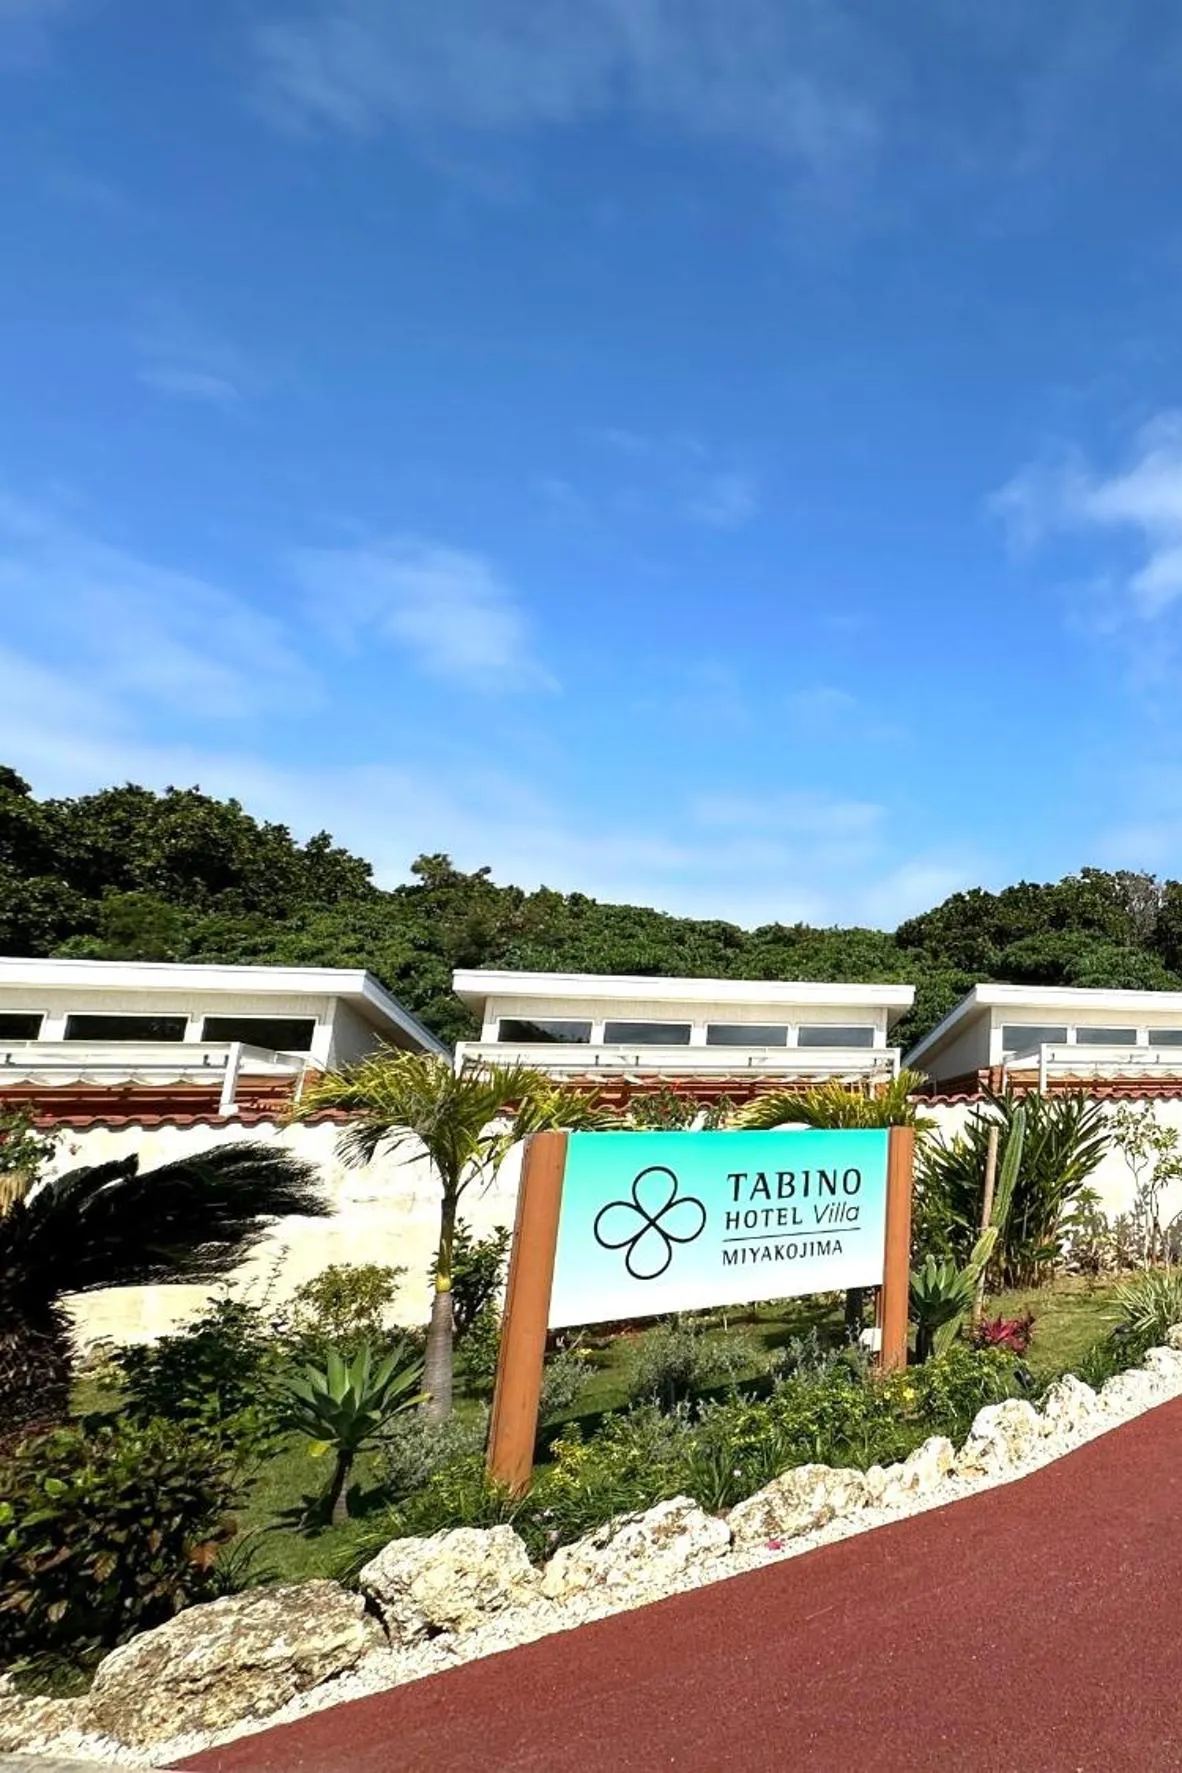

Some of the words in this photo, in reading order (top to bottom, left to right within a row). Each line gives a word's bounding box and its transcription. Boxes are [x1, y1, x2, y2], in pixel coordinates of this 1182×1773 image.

[727, 1168, 862, 1202] TABINO
[725, 1207, 803, 1230] HOTEL
[813, 1202, 860, 1224] Villa
[721, 1239, 843, 1266] MIYAKOJIMA
